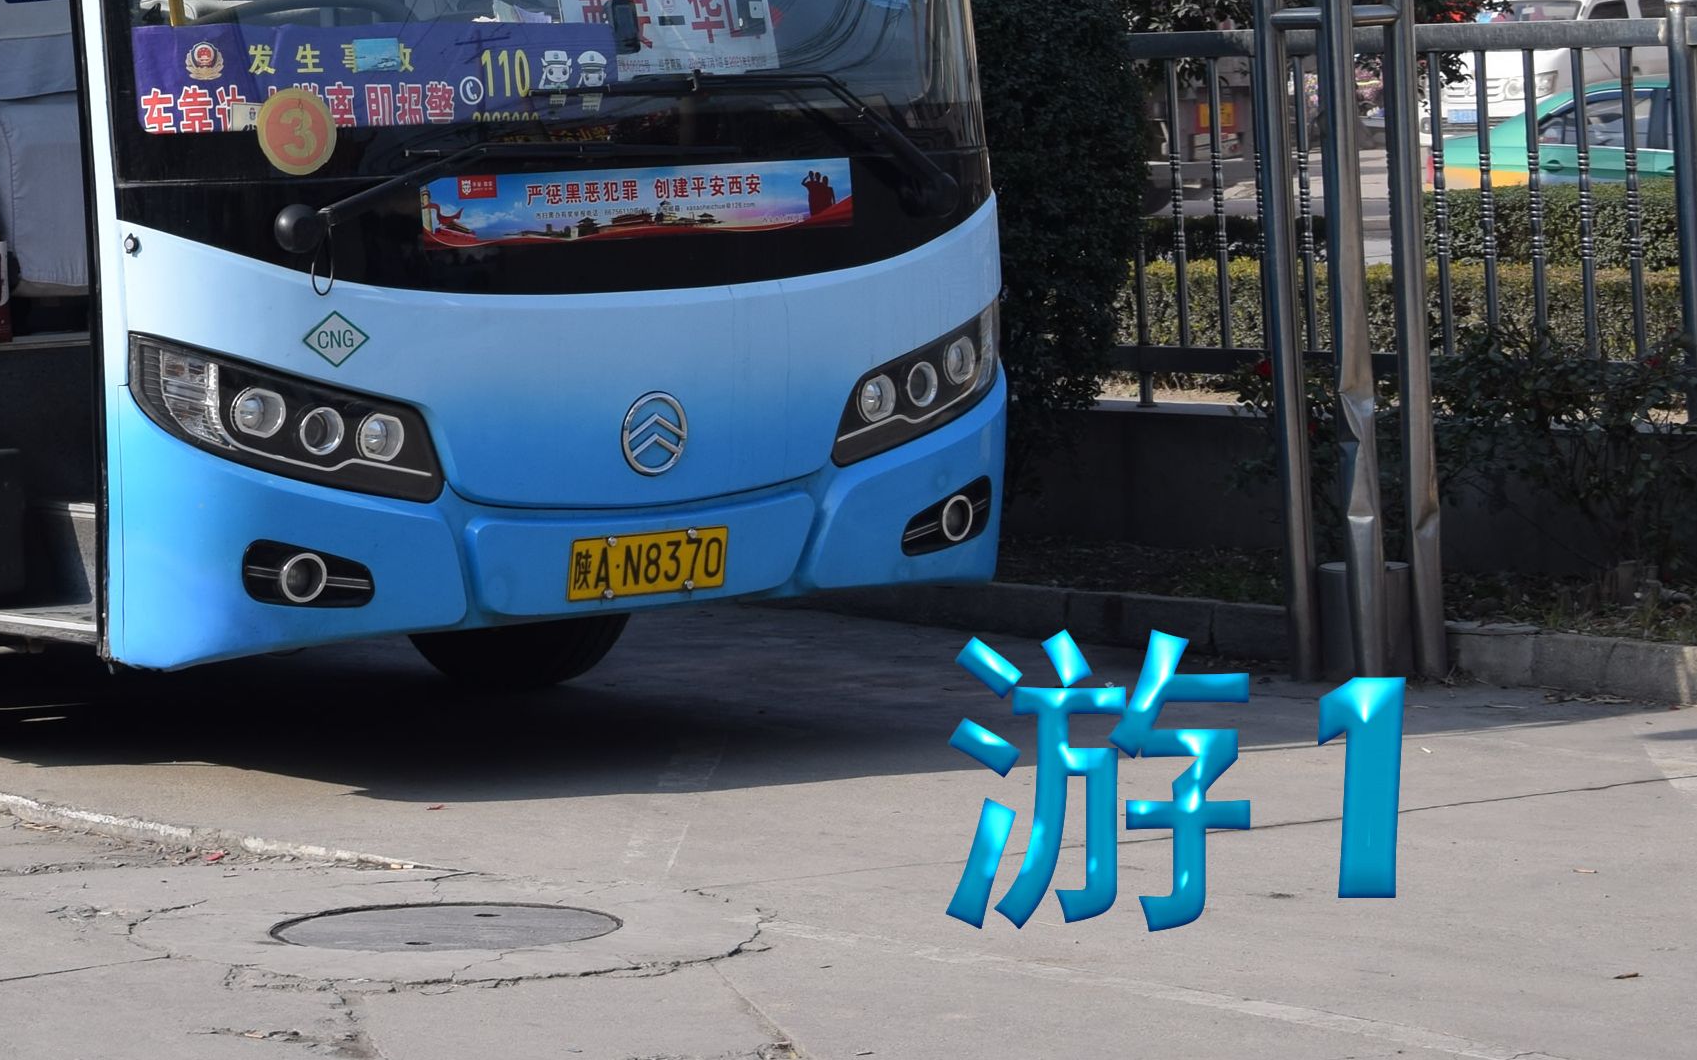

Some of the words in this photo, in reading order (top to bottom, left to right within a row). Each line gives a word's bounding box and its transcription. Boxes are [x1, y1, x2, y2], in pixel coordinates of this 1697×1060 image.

[480, 48, 531, 99] 110
[279, 108, 318, 158] 3
[525, 179, 639, 206] 严惩黑恶犯罪
[654, 173, 761, 200] 创建平安西安
[317, 329, 354, 349] CNG
